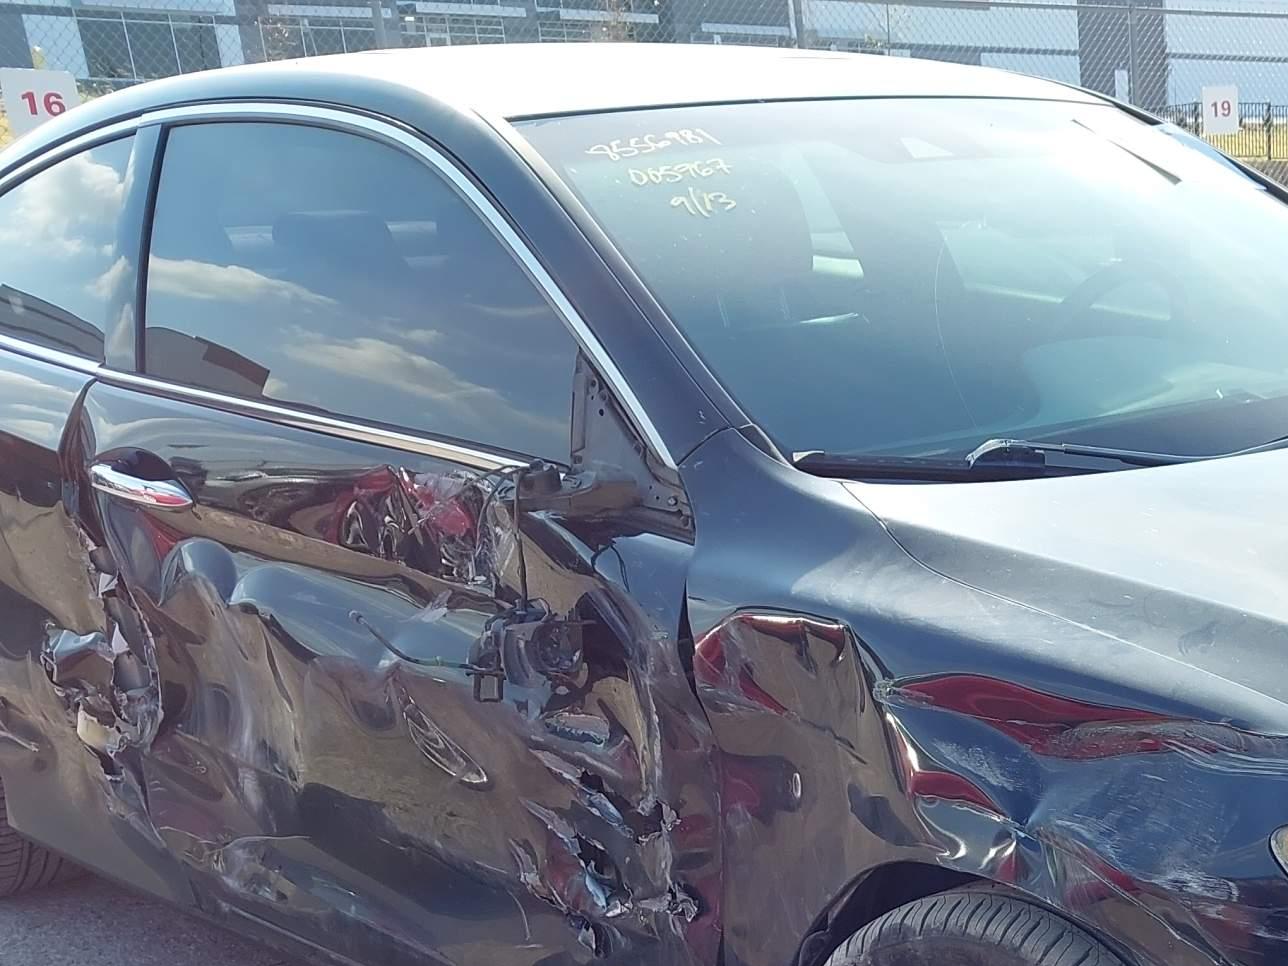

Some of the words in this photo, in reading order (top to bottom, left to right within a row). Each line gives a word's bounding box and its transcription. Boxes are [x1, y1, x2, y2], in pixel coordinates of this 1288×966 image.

[21, 91, 66, 117] 16
[1210, 100, 1231, 117] 19
[670, 186, 737, 218] 9/13
